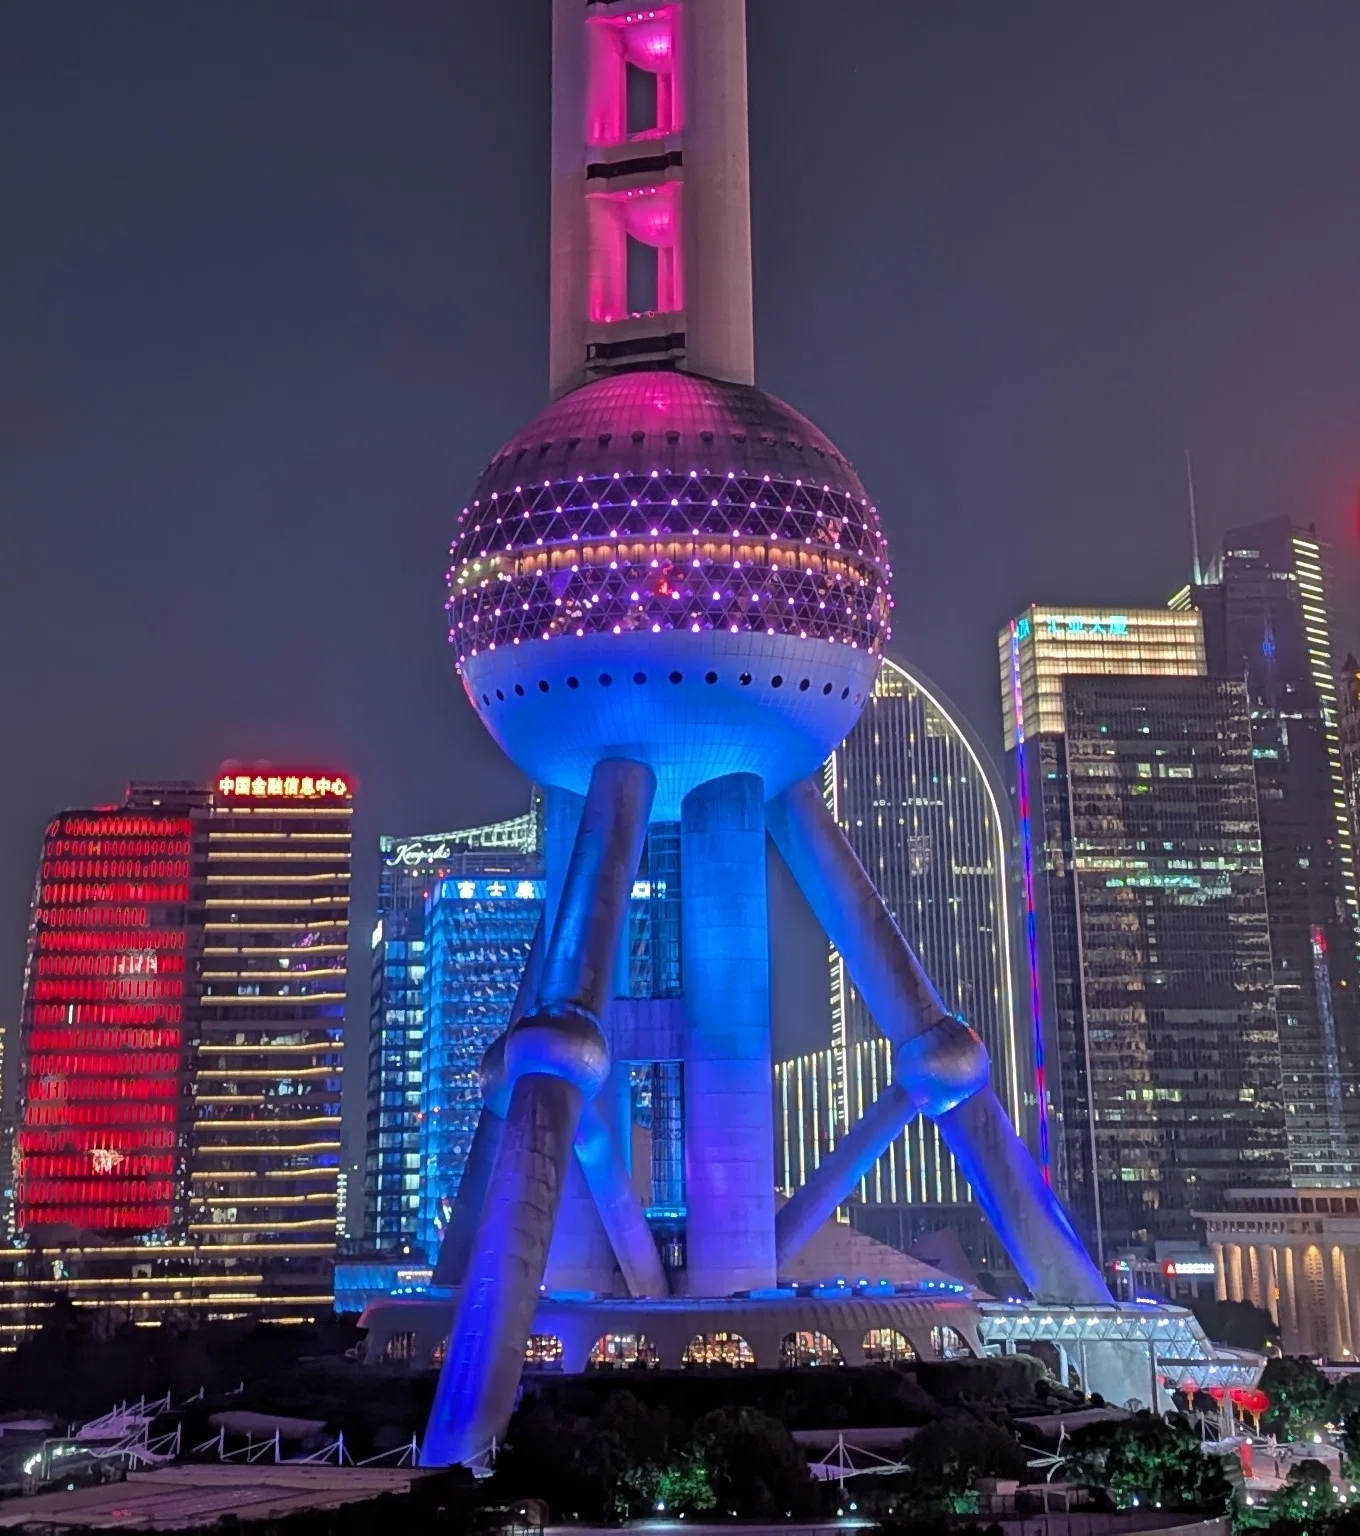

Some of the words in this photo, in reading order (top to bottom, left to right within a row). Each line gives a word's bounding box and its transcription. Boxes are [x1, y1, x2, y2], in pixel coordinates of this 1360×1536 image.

[219, 775, 347, 796] 中国金融信息中心
